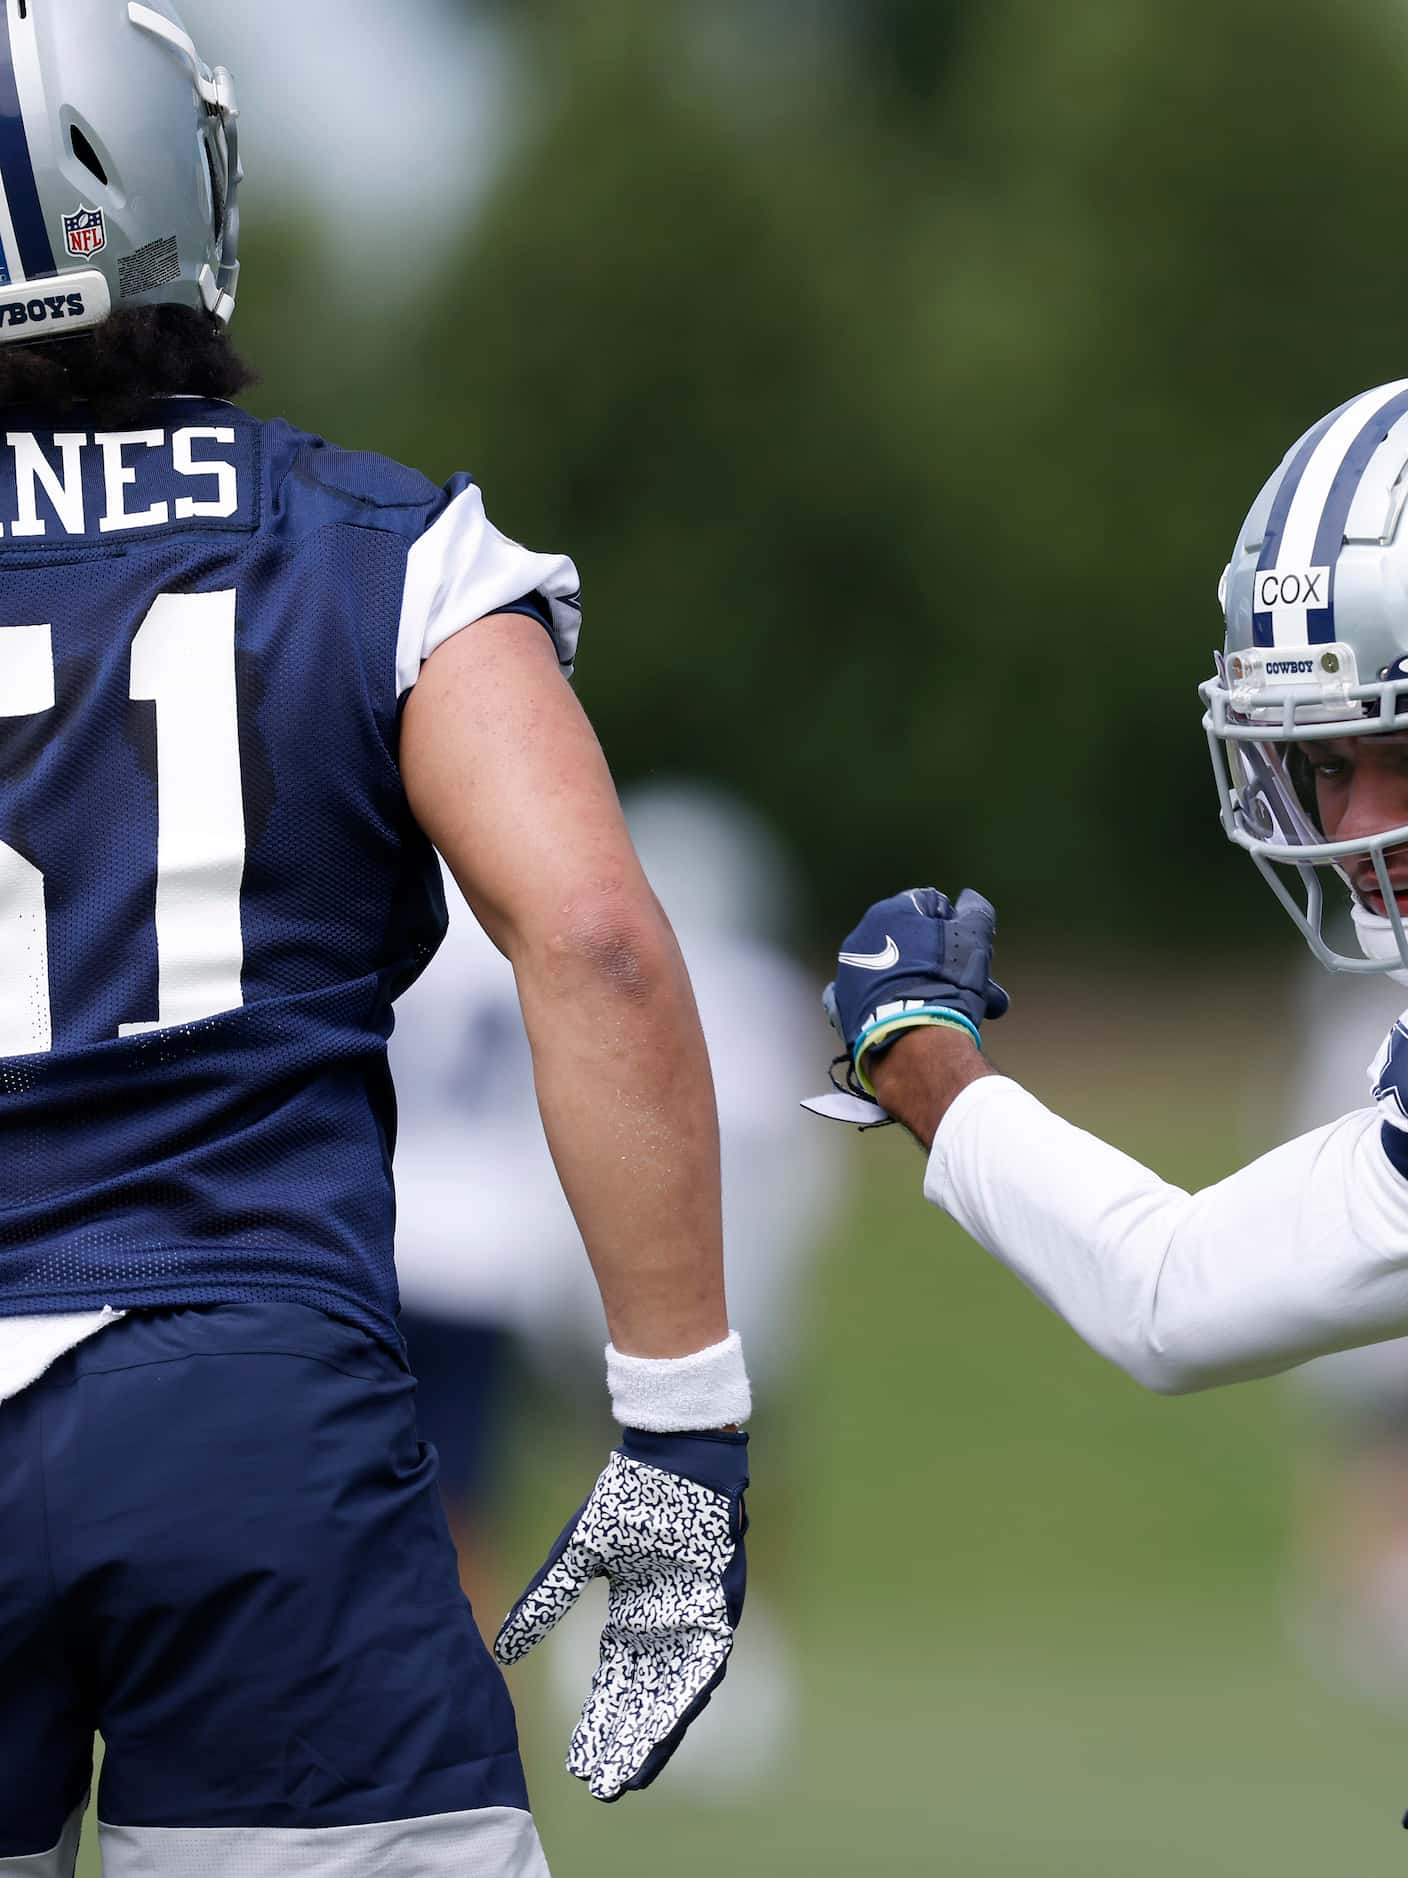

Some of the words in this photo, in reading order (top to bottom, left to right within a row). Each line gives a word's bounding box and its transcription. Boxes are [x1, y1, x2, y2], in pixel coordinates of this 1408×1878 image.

[69, 228, 102, 252] NFL
[0, 426, 237, 538] NES
[1261, 573, 1321, 607] COX
[1265, 660, 1313, 675] COWBOY
